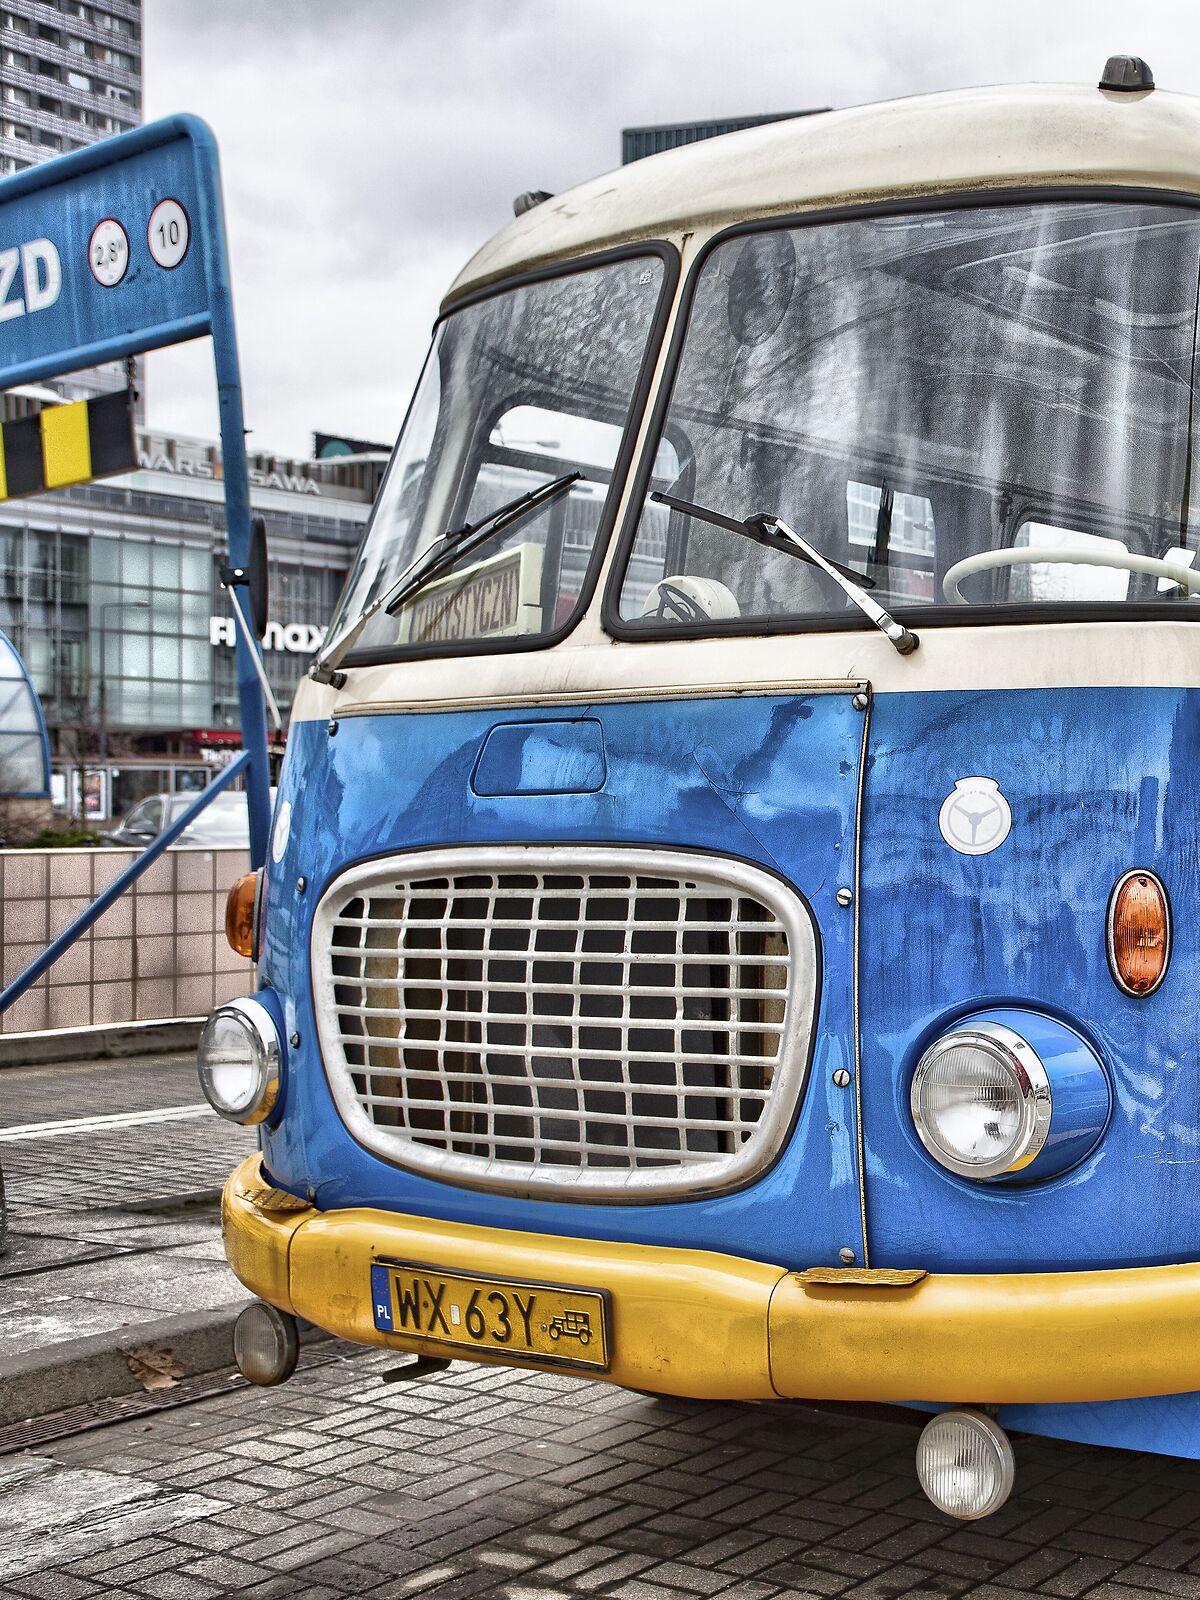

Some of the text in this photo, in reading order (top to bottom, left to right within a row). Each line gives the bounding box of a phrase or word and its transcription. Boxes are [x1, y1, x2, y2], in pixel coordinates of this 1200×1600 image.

[158, 220, 180, 249] 10
[249, 468, 321, 496] SAWA
[377, 1304, 391, 1320] PL
[395, 1276, 537, 1348] WX 63Y
